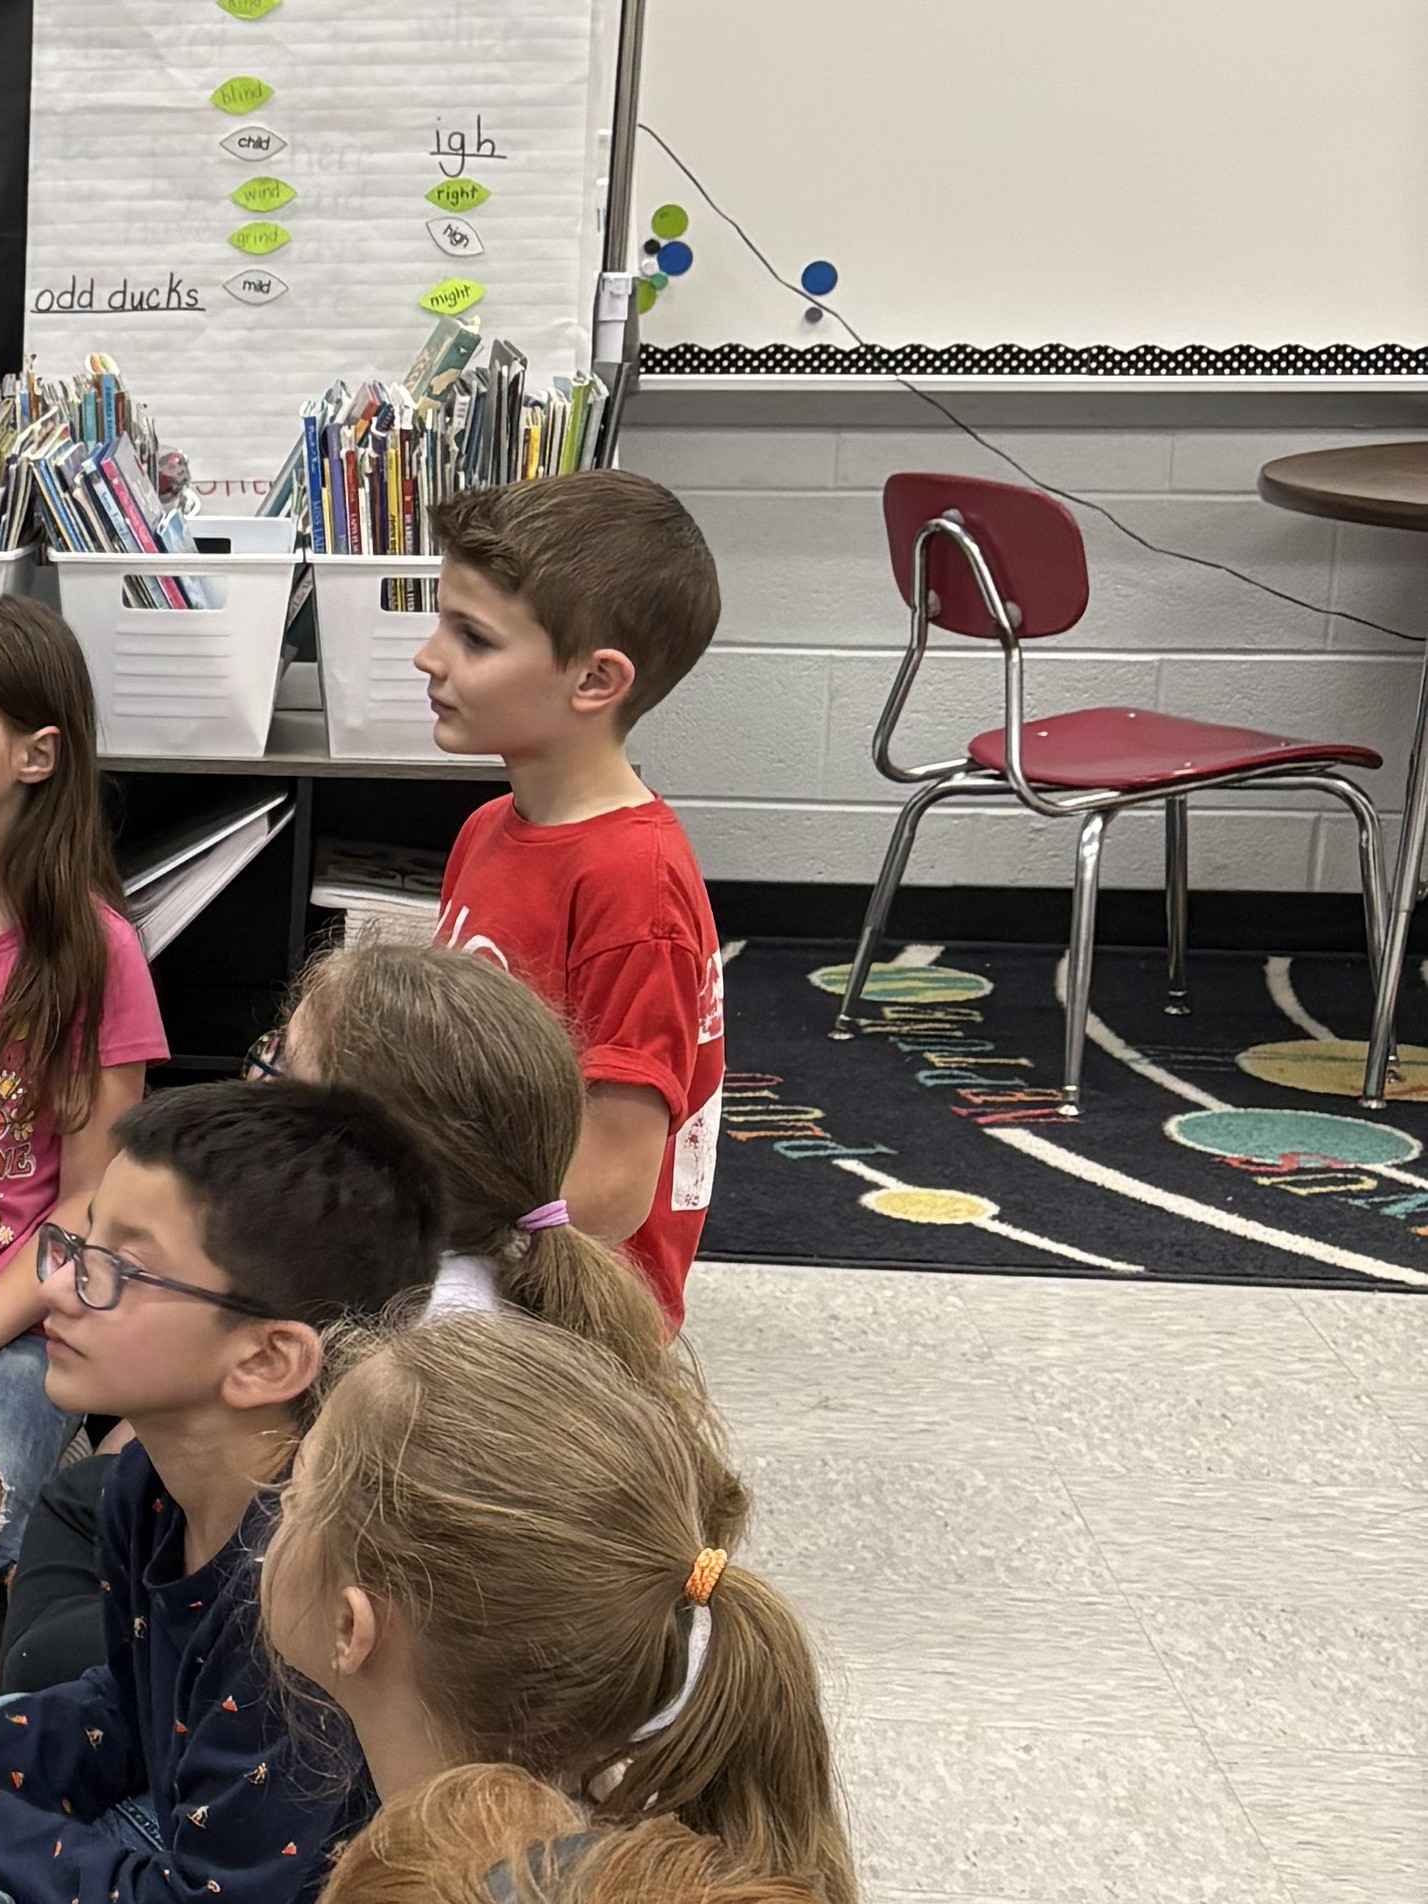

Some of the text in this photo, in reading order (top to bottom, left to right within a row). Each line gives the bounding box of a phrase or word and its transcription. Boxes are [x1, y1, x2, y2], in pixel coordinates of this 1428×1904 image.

[222, 83, 263, 105] blind
[238, 114, 496, 178] child igh
[437, 188, 478, 207] right
[35, 272, 199, 312] odd ducks
[430, 284, 472, 308] might
